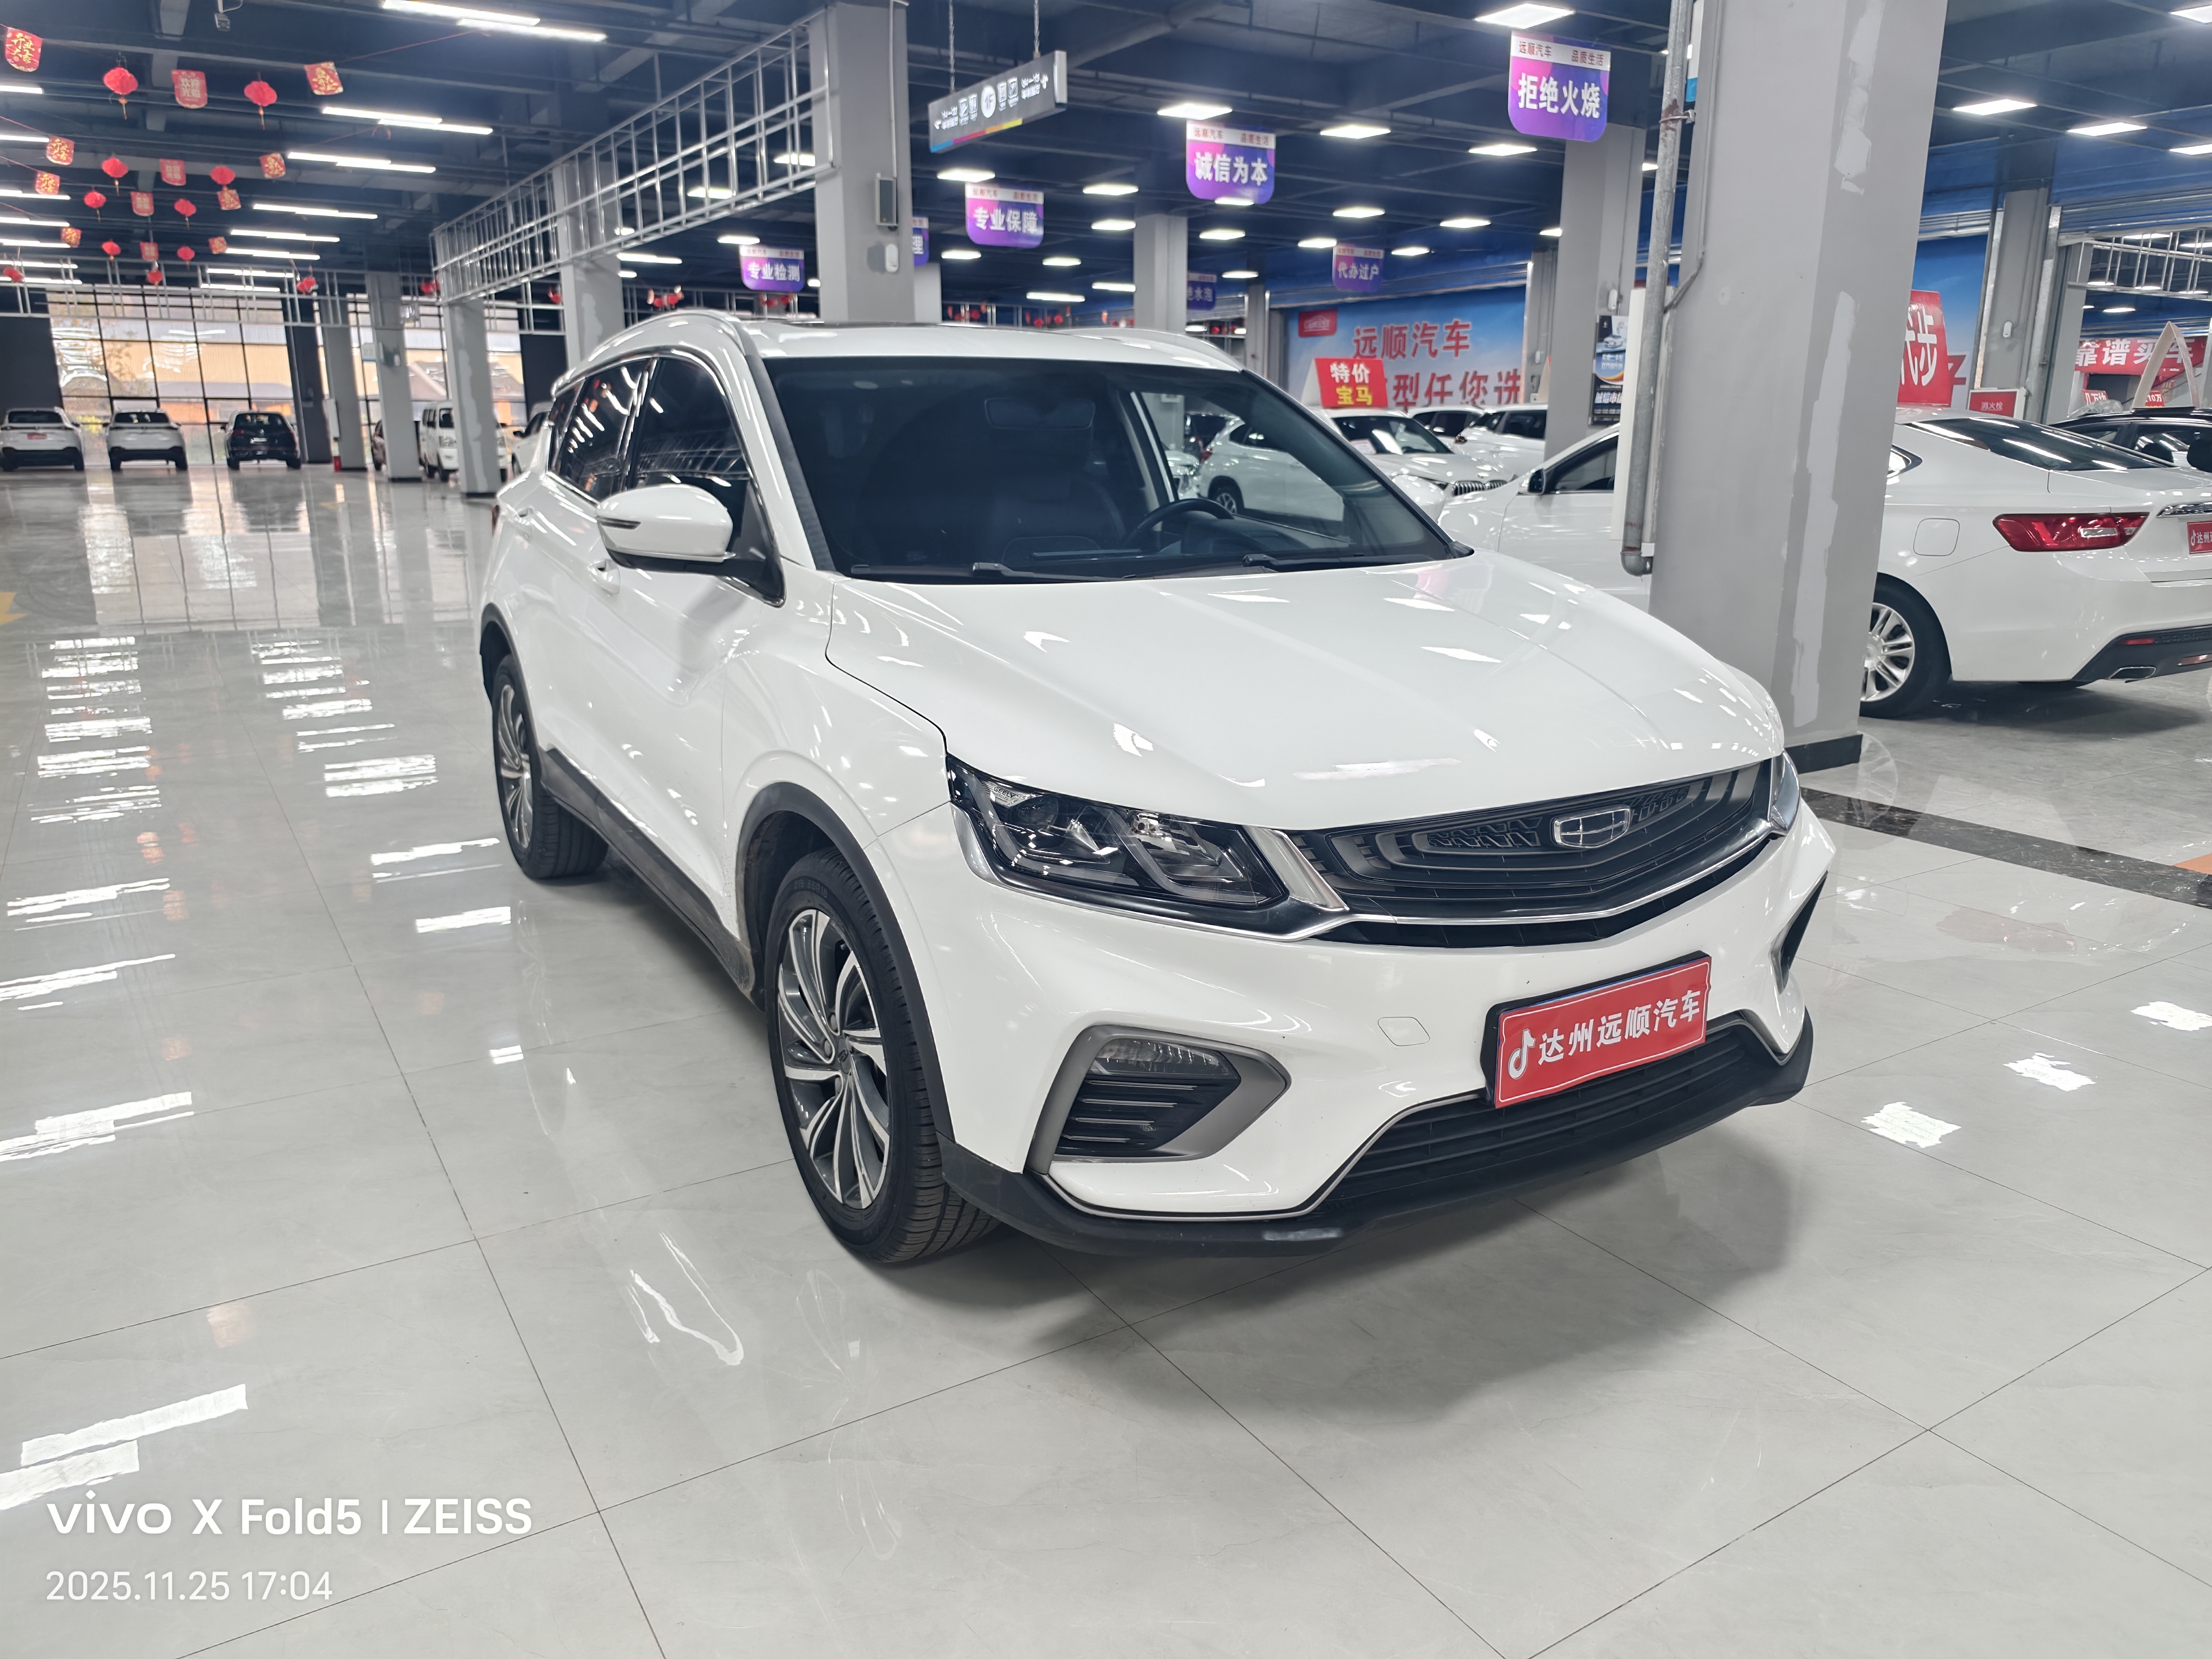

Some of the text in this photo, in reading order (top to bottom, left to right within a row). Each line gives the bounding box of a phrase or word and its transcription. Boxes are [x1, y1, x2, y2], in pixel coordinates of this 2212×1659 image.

[1518, 72, 1601, 119] 拒绝火烧
[1193, 151, 1269, 186] 诚信为本
[973, 206, 1038, 234] 专业保障
[747, 261, 800, 282] 专业检测
[1338, 261, 1379, 280] 代办过户
[1352, 318, 1471, 360] 远顺汽车
[1330, 363, 1370, 384] 特价
[1336, 386, 1373, 406] 宝马
[1386, 368, 1521, 414] 型任您选
[2146, 394, 2162, 402] 10万
[1537, 989, 1702, 1065] 达州远顺汽车
